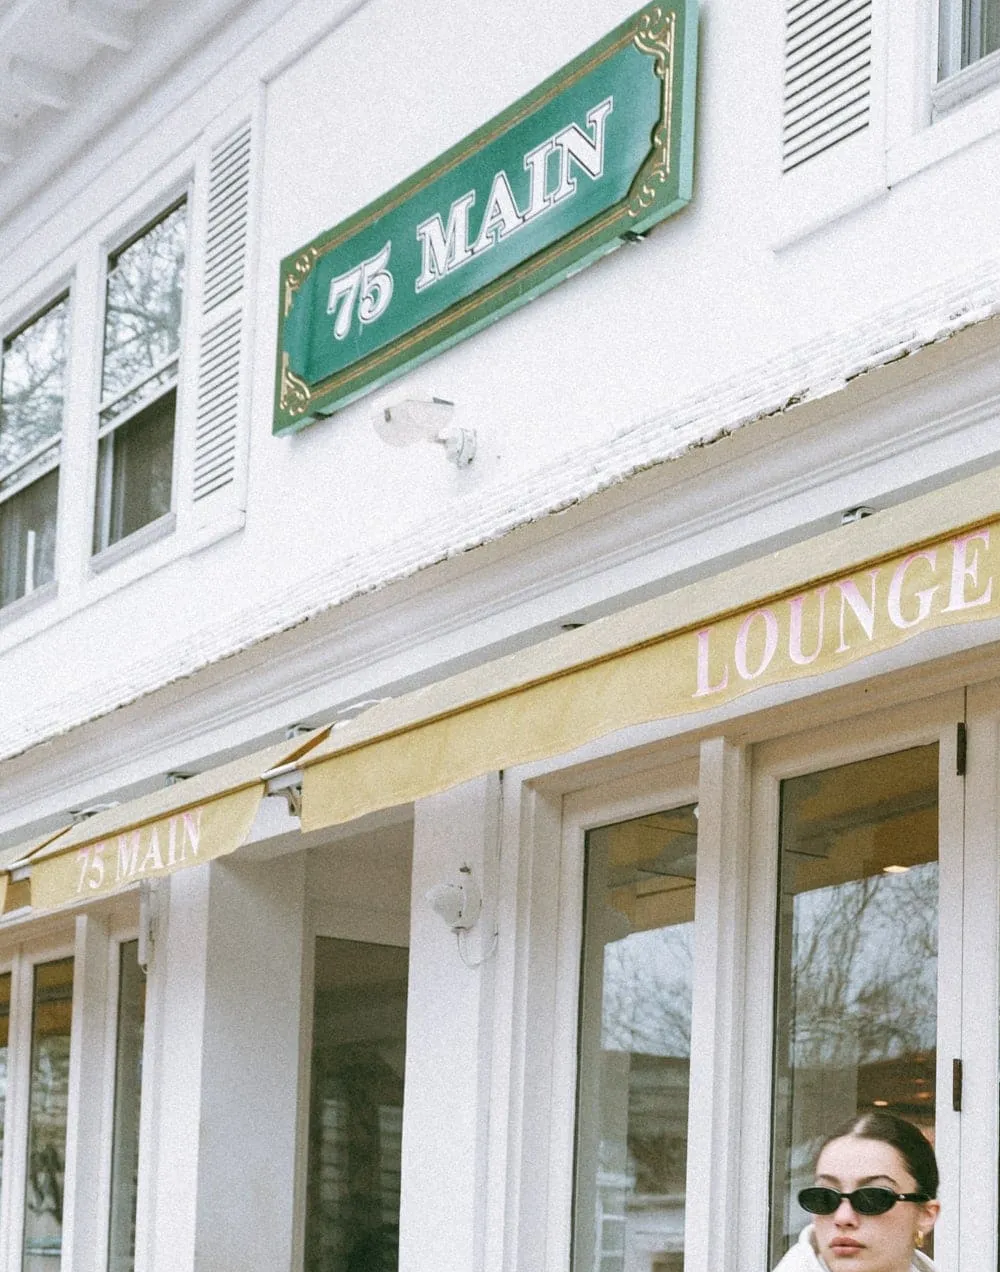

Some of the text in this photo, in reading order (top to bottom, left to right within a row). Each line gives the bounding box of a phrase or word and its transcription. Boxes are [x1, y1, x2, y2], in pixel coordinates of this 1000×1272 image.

[327, 96, 613, 340] 75 MAIN
[692, 530, 992, 698] LOUNGE
[75, 806, 203, 893] 75 MAIN
